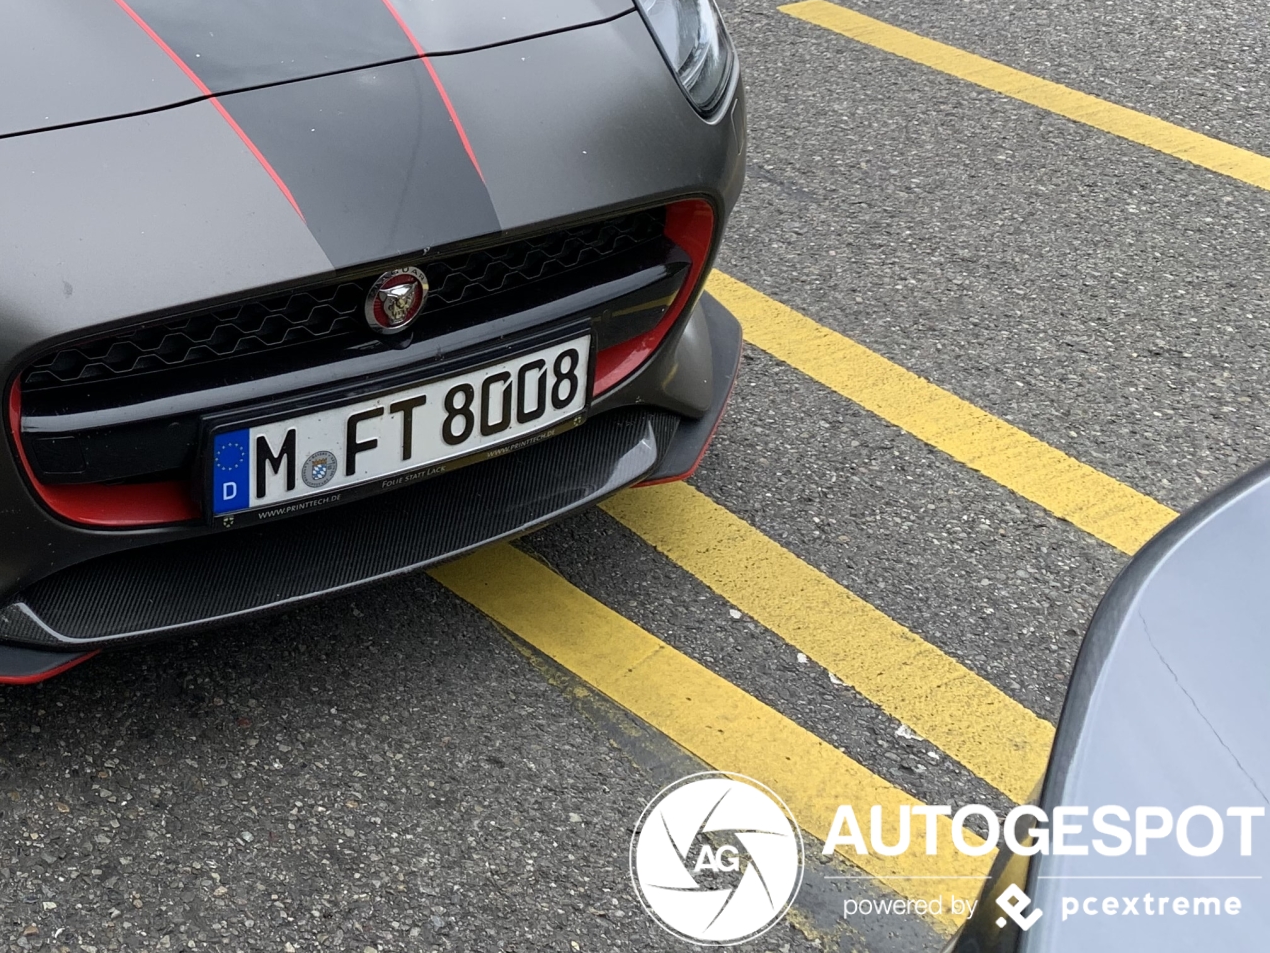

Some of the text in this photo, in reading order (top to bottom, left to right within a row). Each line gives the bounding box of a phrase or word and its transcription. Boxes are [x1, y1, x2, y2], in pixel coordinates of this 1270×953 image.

[256, 428, 296, 498] M
[345, 395, 427, 476] FT
[442, 349, 579, 445] 8008
[223, 482, 237, 500] D
[258, 494, 342, 519] WWW.PRINTTECH.DE
